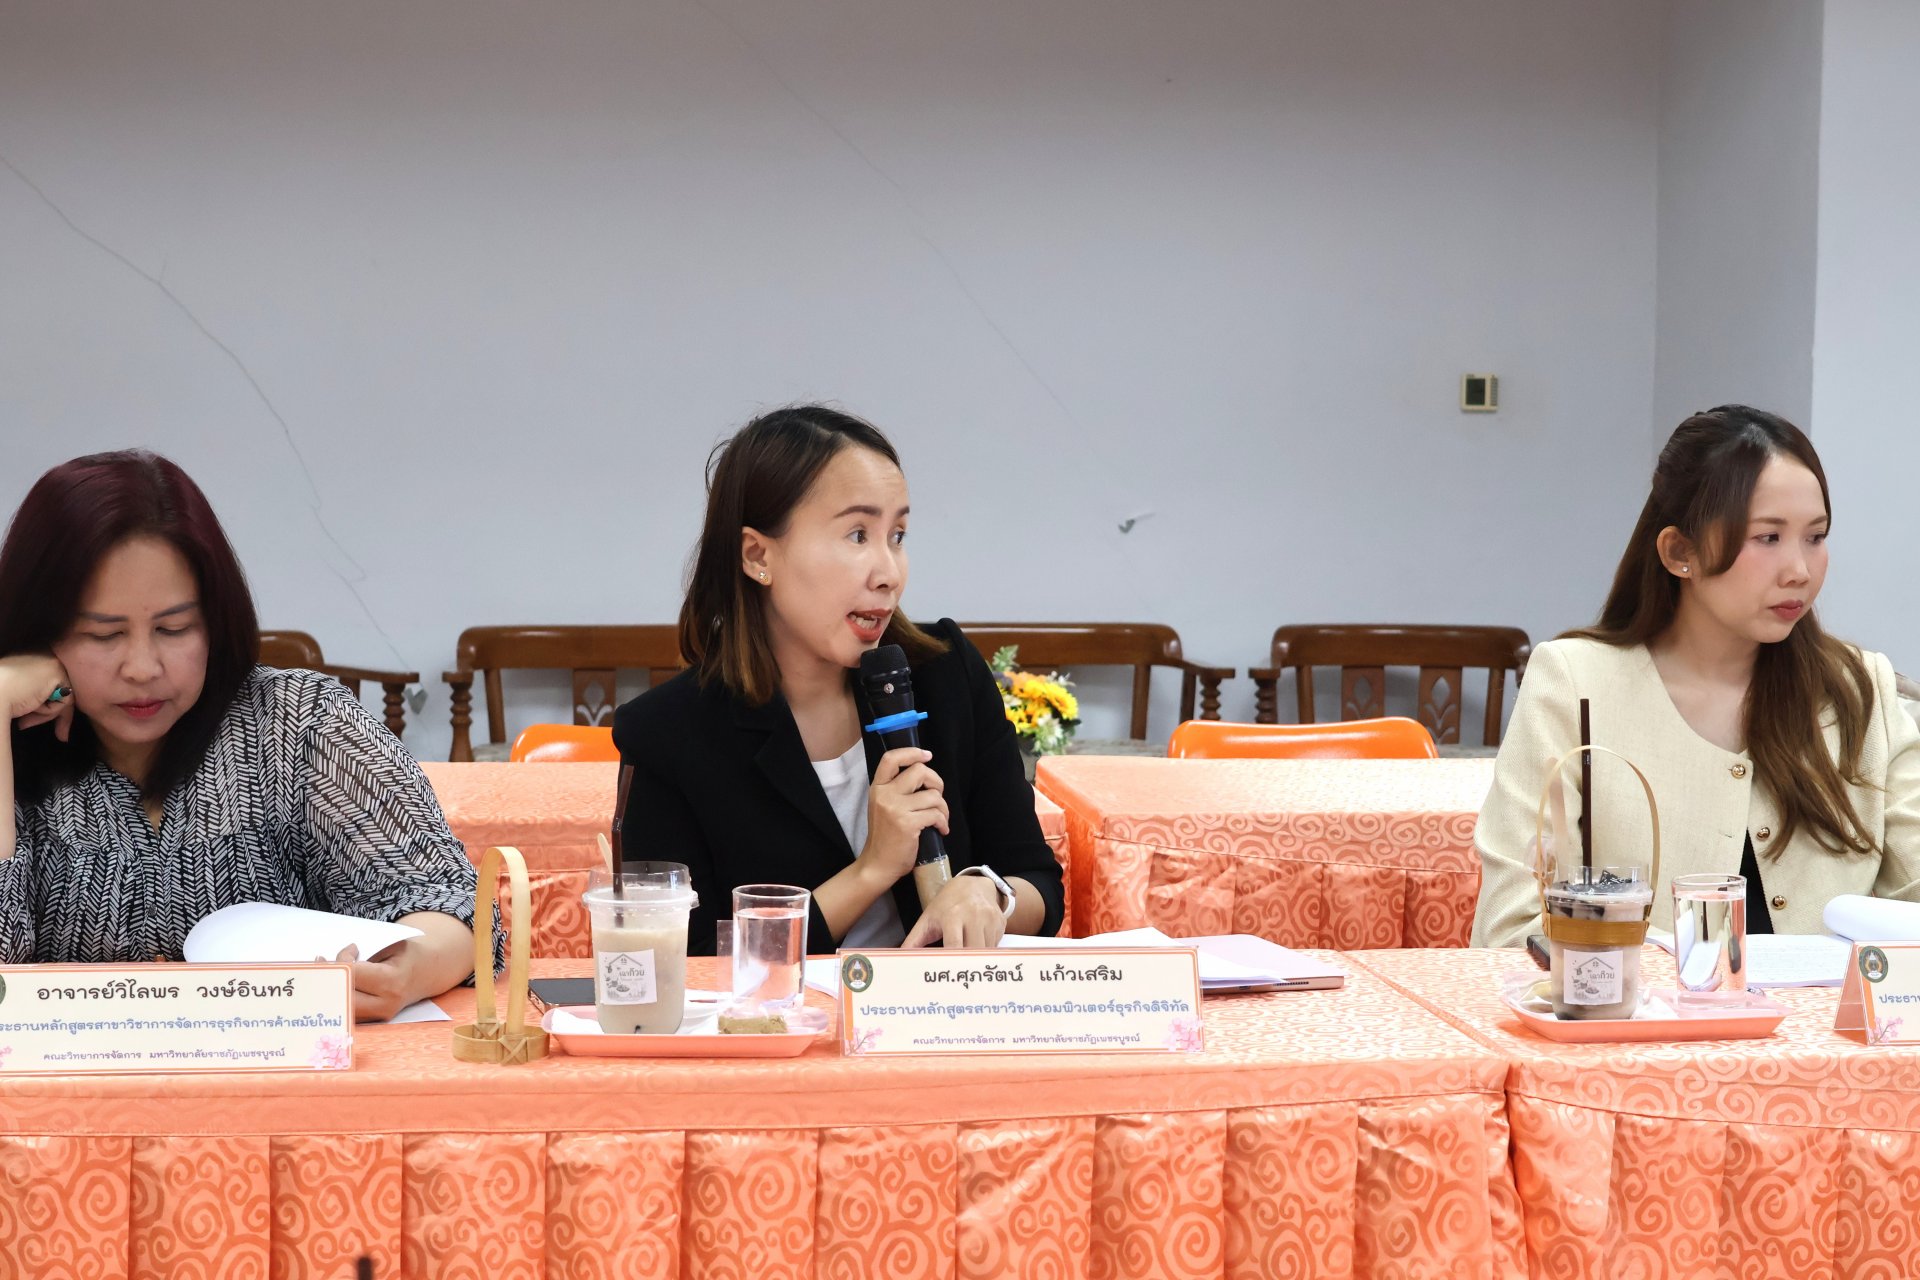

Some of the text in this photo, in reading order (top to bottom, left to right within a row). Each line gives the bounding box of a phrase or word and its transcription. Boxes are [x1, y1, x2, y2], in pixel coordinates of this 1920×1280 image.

[923, 962, 1123, 990] ผศ.ศุภรัตน์ แก้วเสริม
[36, 977, 295, 1001] อาจารย์วิไลพร วงษ์อินทร์
[859, 999, 1189, 1020] ประธานหลักสูตรสาขาวิชาคอมพิวเตอร์ธุรกิจดิจิทัล
[913, 1033, 1140, 1046] คณะวิทยาการจัดการ มหาวิทยาลัยราชภัฏเพชรบูรณ์
[43, 1047, 286, 1061] คณะวิทยาการจัดการ มหาวิทยาลัยราชภัฏเพชรบูรณ์
